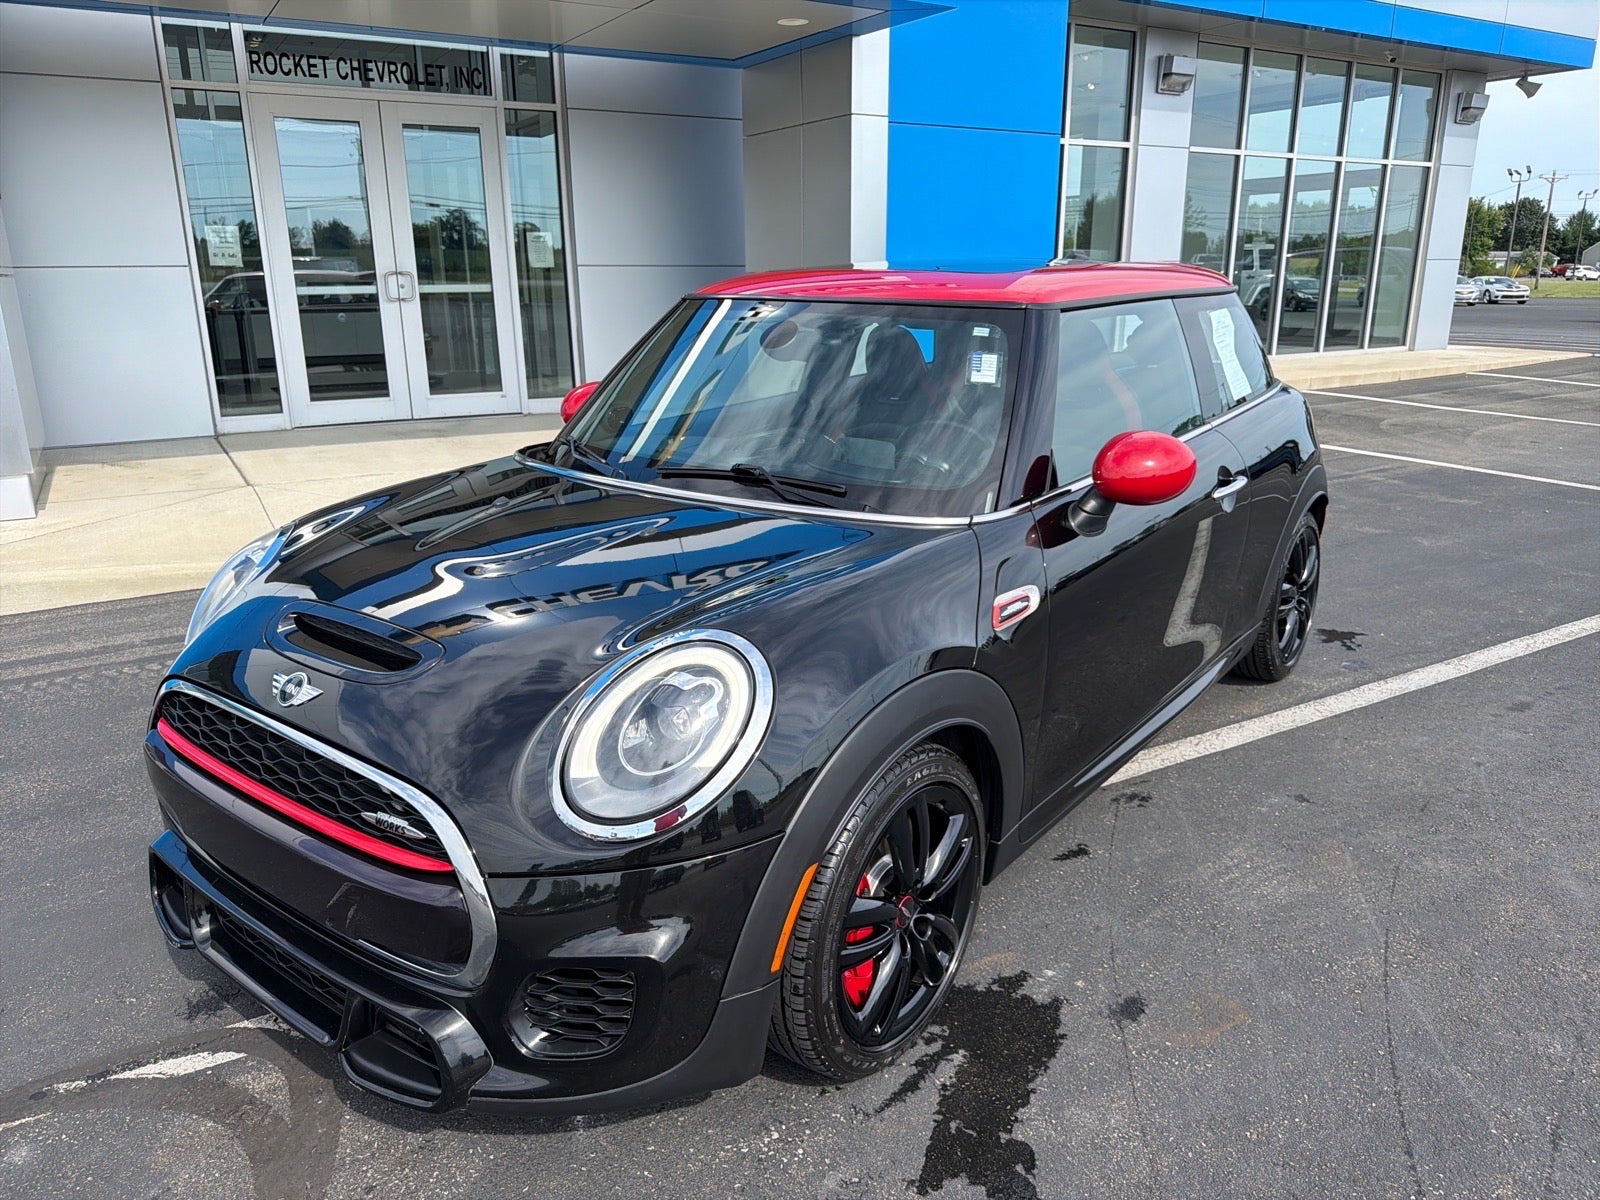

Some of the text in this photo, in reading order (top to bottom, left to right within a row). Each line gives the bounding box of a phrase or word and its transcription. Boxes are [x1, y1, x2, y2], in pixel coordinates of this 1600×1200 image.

[248, 50, 329, 79] ROCKET
[336, 57, 449, 91] CHEVROLET,
[375, 817, 407, 835] WORKS
